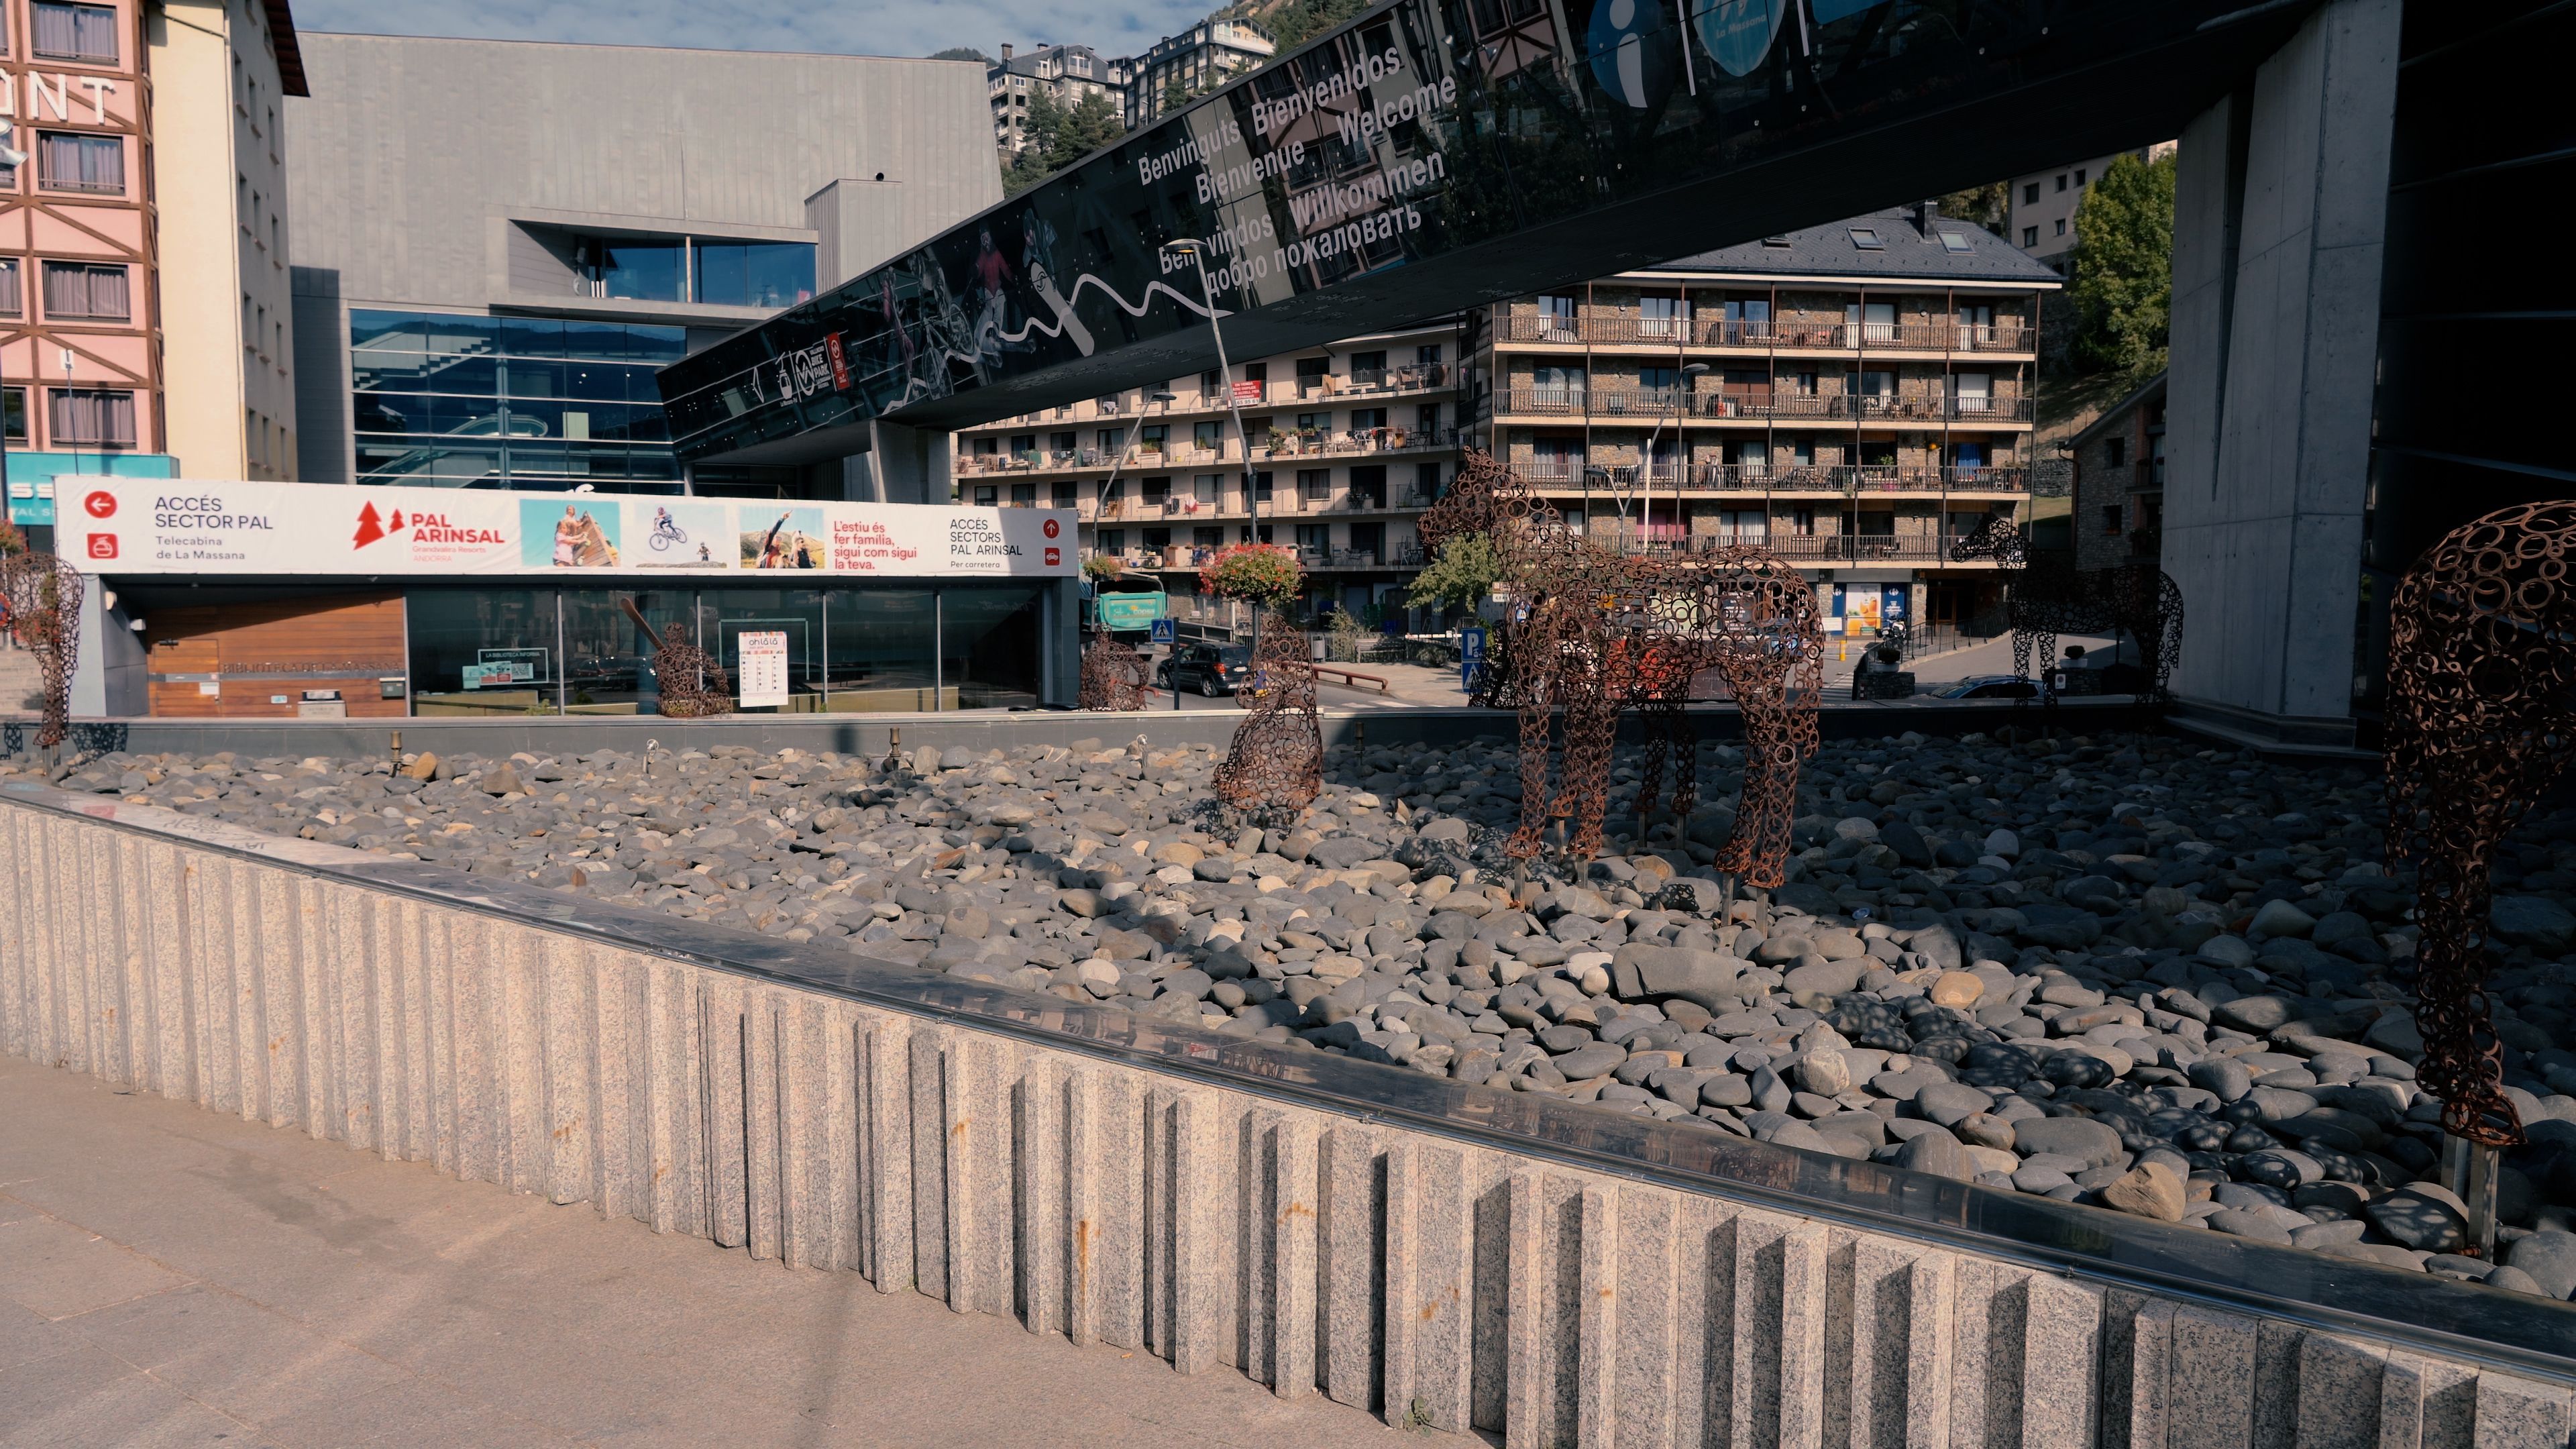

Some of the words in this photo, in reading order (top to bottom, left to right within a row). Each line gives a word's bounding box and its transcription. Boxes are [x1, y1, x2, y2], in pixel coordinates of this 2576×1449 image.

[1716, 29, 1726, 39] La
[1728, 14, 1767, 34] Massana
[1138, 120, 1242, 186] Benvinguts
[1252, 46, 1401, 137] Bienvenidos
[1195, 140, 1305, 205] Bienvenue
[1336, 75, 1457, 147] Welcome
[1288, 152, 1446, 229] Willkommen
[1207, 255, 1267, 298] добро
[1273, 205, 1422, 274] пожаловать
[811, 354, 824, 366] BIKE
[814, 363, 830, 378] PARK
[154, 494, 221, 512] ACCÉS
[156, 513, 233, 529] SECTOR
[239, 515, 273, 529] PAL
[411, 513, 451, 527] PAL
[834, 521, 869, 532] L'estiu
[872, 522, 885, 533] és
[950, 517, 988, 530] ACCÉS
[156, 536, 222, 545] Telecabina
[413, 529, 504, 543] ARINSAL
[834, 533, 850, 544] fer
[853, 533, 895, 547] família,
[950, 531, 1001, 543] SECTORS
[156, 550, 172, 559] de
[176, 551, 189, 559] La
[193, 551, 245, 559] Massana
[835, 546, 860, 559] sigui
[864, 549, 888, 557] com
[891, 547, 916, 560] sigui
[951, 545, 971, 555] PAL
[976, 545, 1022, 555] ARINSAL
[835, 558, 844, 569] la
[848, 559, 875, 570] teva.
[1467, 633, 1479, 655] P
[223, 662, 297, 674] BIBLIOTECA
